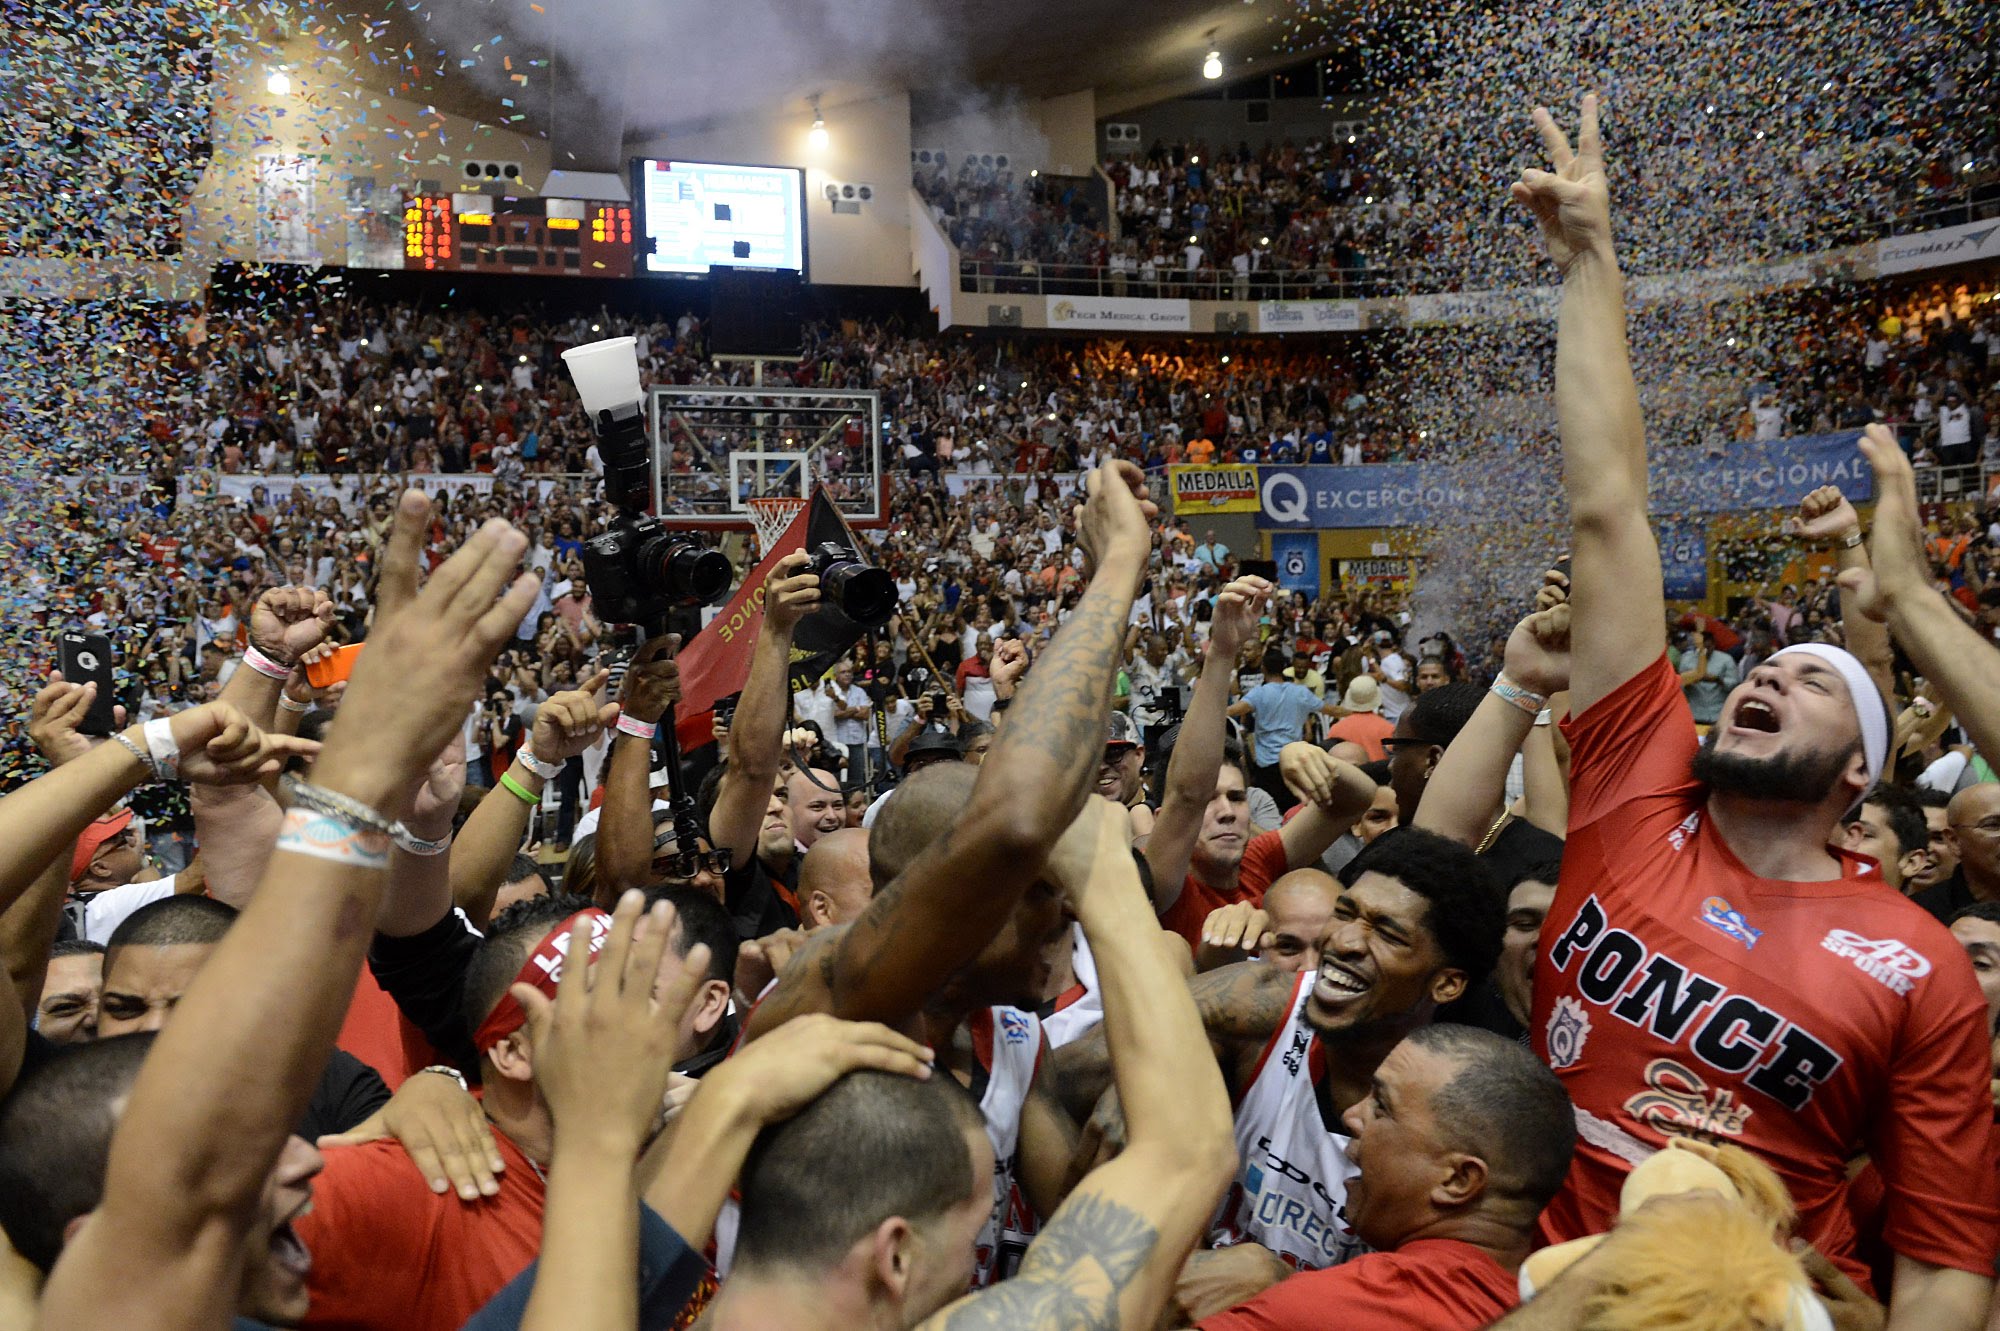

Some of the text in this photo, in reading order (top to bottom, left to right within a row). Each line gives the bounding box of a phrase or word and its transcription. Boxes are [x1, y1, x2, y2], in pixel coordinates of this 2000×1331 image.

[1177, 471, 1255, 491] MEDALLA
[1262, 472, 1311, 523] Q
[1549, 893, 1844, 1112] PONCE
